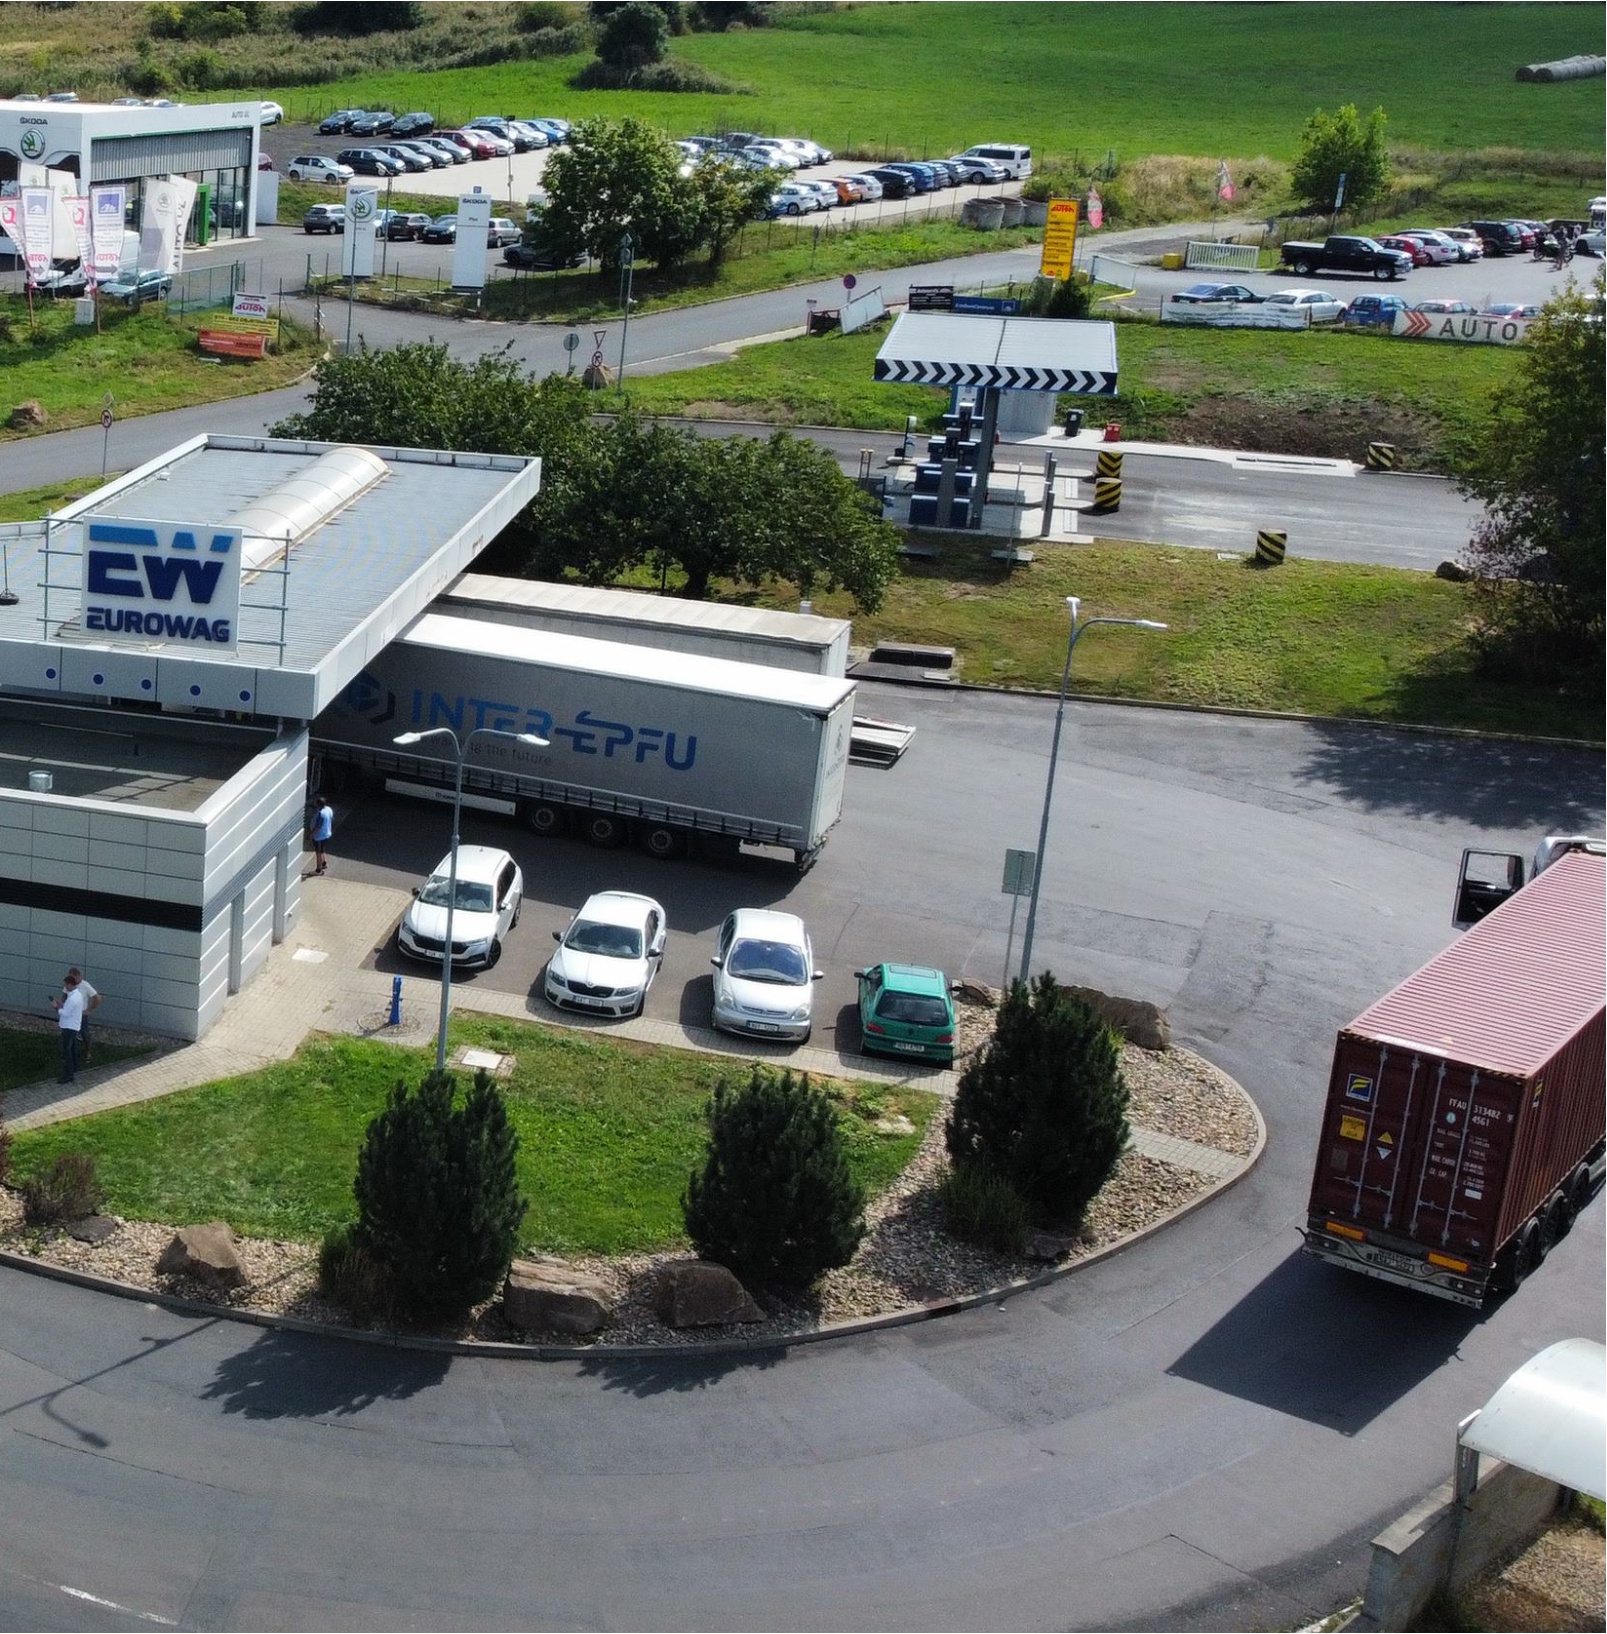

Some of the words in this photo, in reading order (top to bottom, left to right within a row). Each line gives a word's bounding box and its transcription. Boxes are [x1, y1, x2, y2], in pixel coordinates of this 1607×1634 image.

[1439, 307, 1535, 342] AUTO
[87, 524, 234, 604] EW
[86, 606, 231, 643] EUROWAG
[512, 748, 553, 766] future
[1449, 1098, 1467, 1110] FFAU
